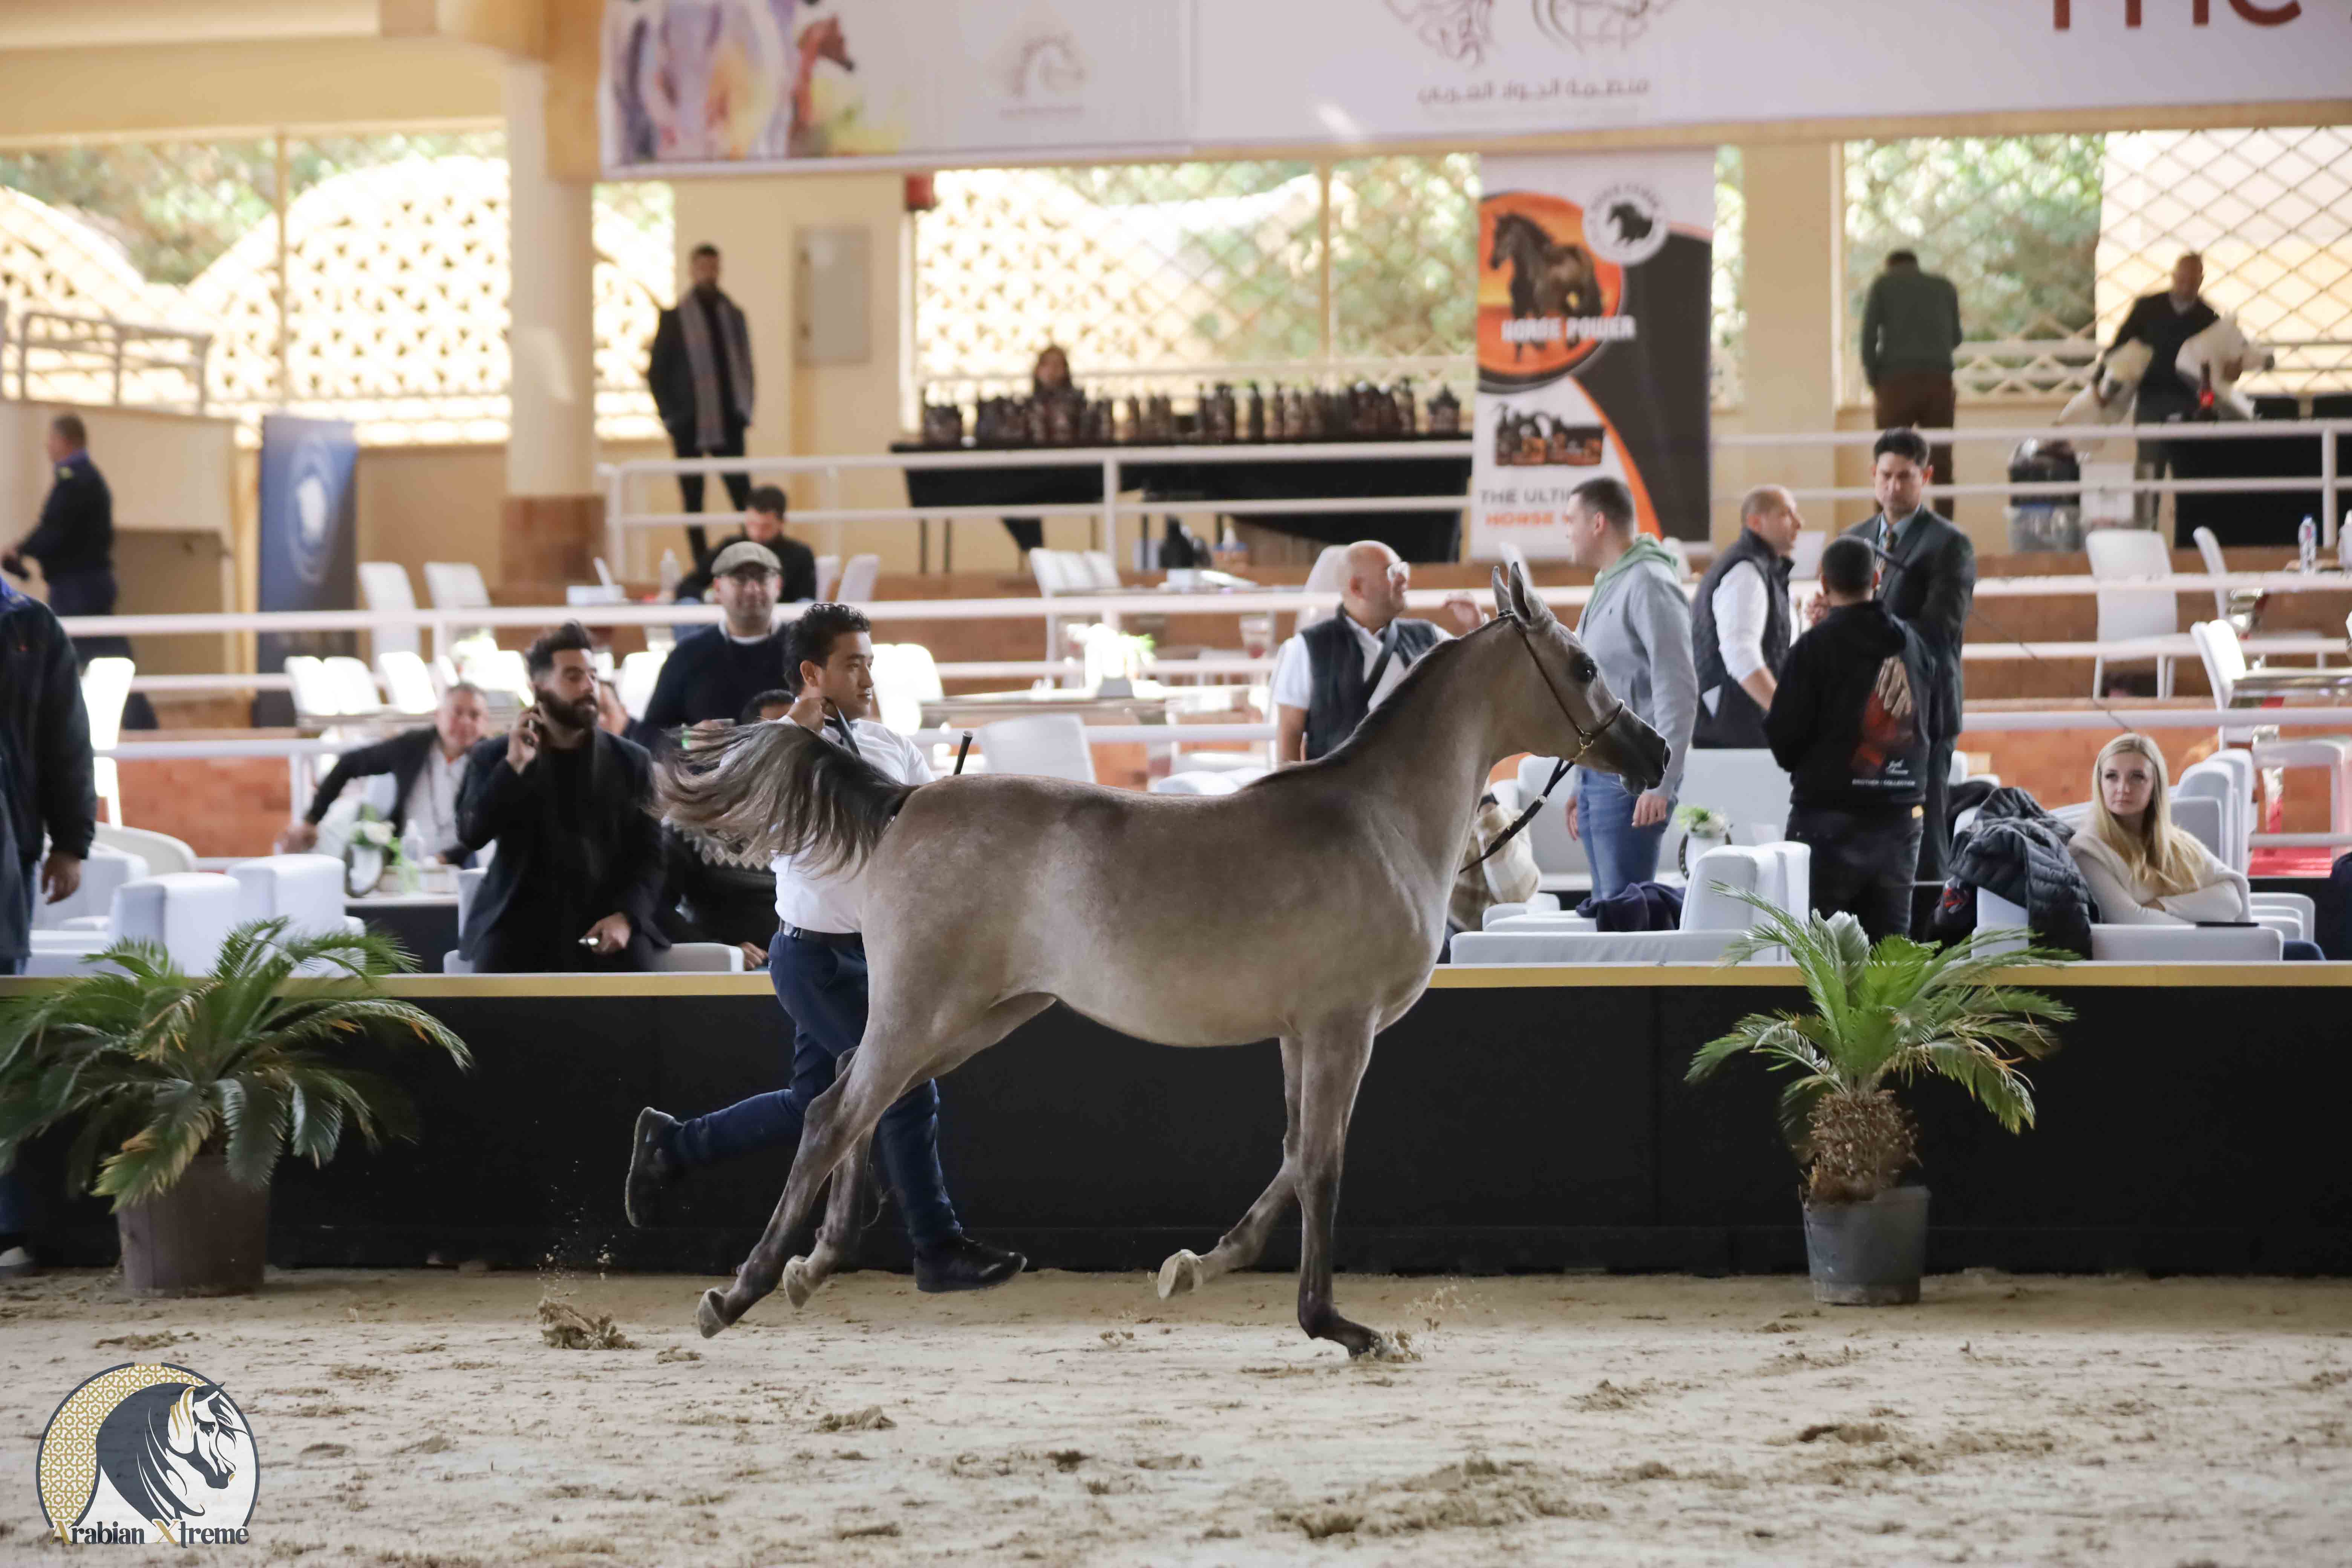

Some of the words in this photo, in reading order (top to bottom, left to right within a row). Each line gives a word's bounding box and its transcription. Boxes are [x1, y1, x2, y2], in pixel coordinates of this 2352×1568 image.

[1501, 317, 1562, 342] HORSE
[1566, 314, 1636, 340] POWER
[1479, 488, 1518, 505] THE
